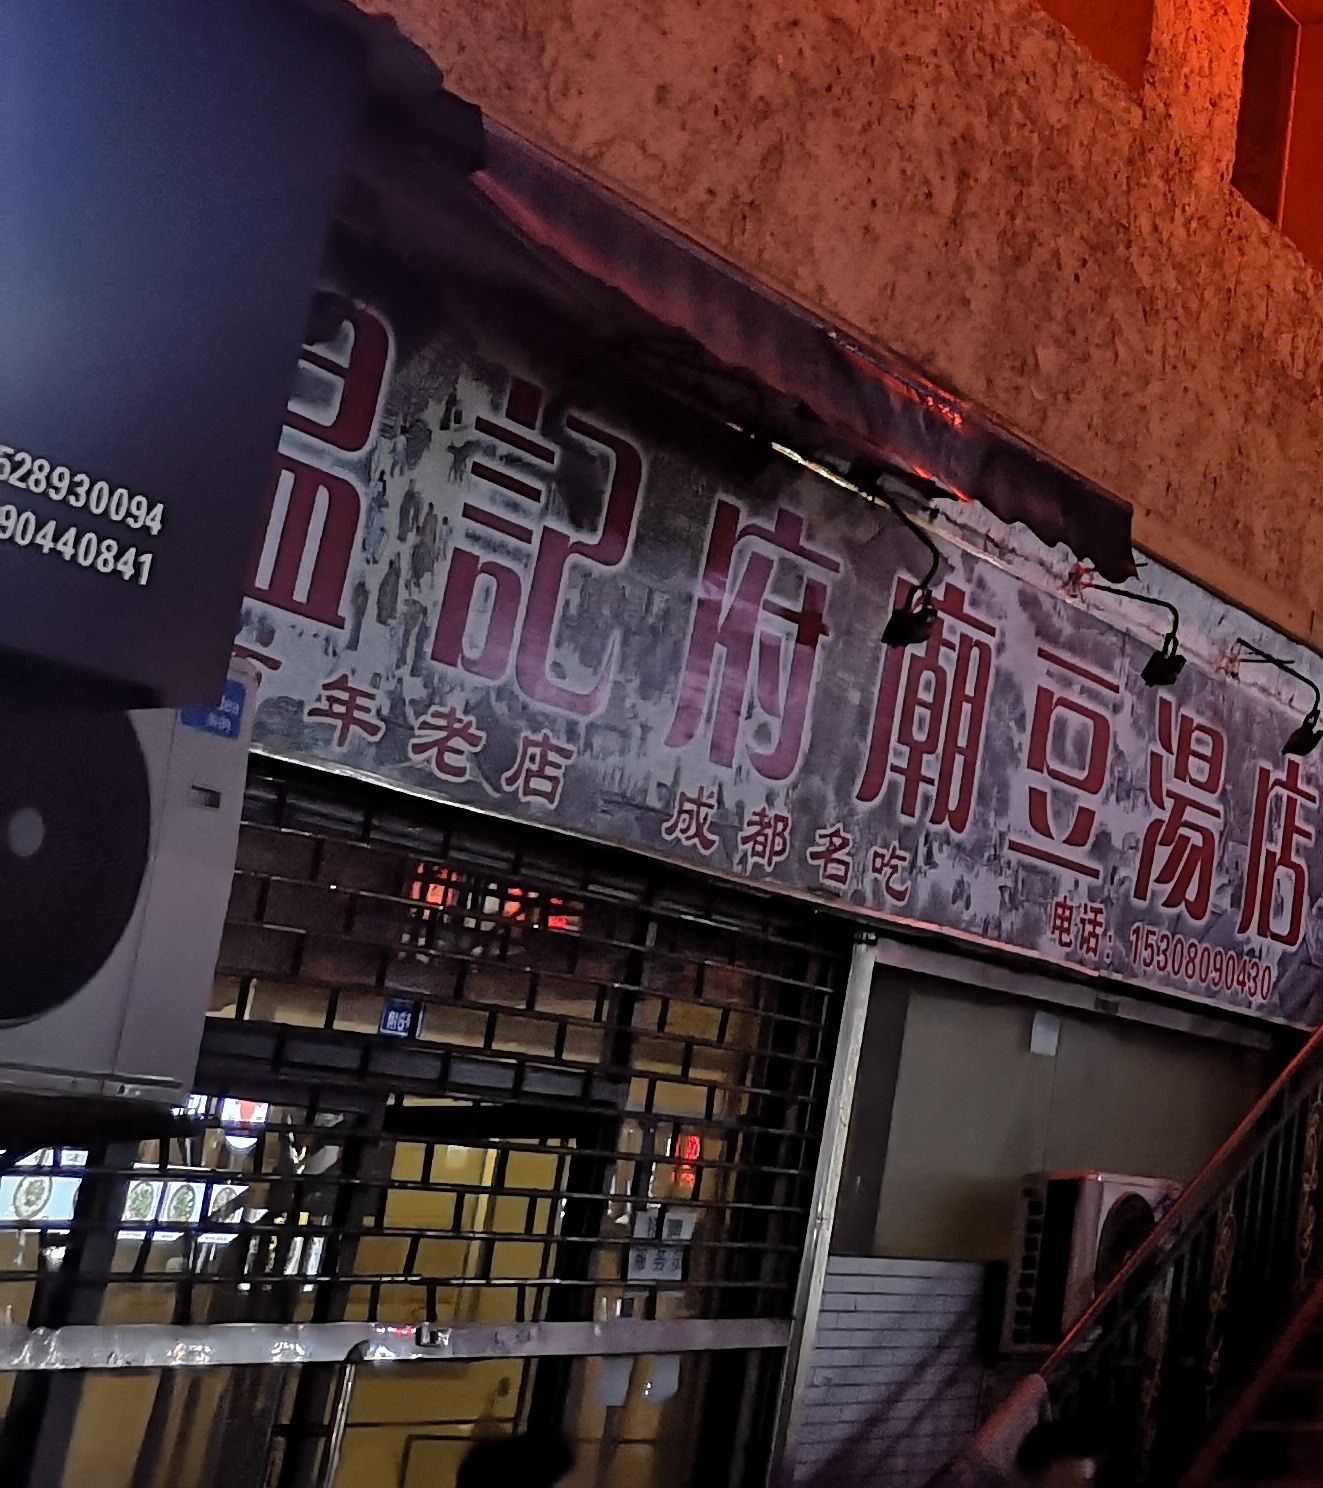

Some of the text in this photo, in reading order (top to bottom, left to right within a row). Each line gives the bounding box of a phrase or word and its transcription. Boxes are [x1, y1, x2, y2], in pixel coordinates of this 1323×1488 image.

[232, 644, 576, 807] 年老店
[665, 789, 909, 903] 成都名吃
